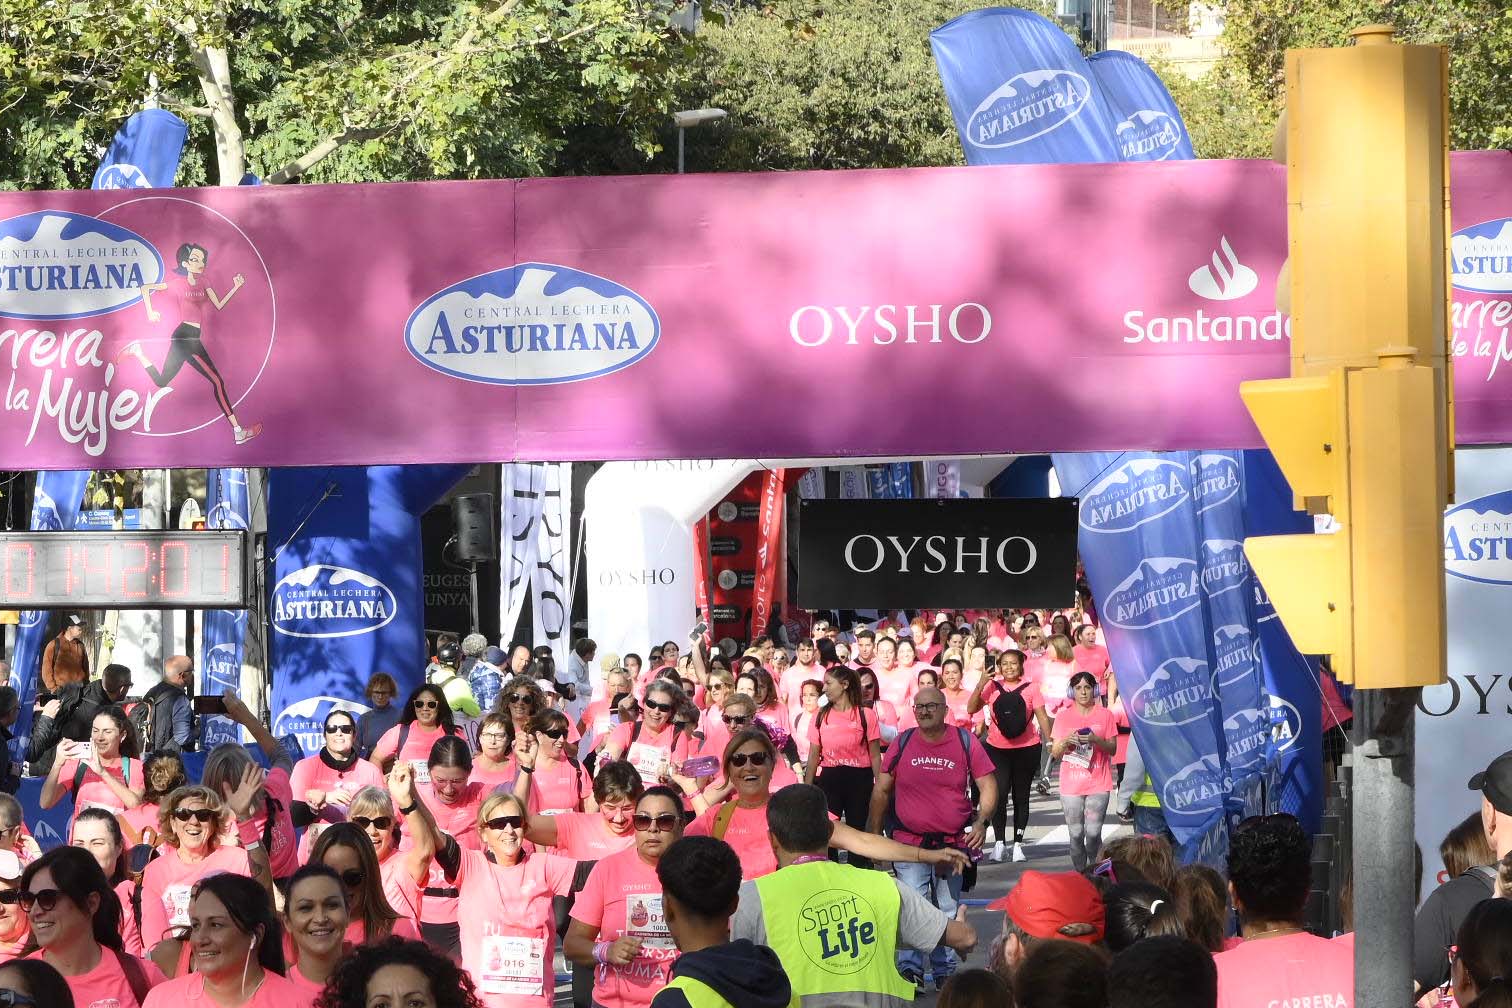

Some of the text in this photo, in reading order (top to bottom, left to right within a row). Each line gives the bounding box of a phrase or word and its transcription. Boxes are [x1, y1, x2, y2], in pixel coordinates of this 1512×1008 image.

[66, 246, 139, 259] LECHERA
[464, 304, 632, 319] CENTRAL LECHERA
[789, 302, 992, 346] OYSHO
[424, 310, 640, 355] ASTURIANA
[5, 370, 30, 412] la
[25, 363, 174, 457] Mujer
[5, 541, 230, 599] 01:42:01
[844, 534, 1038, 575] OYSHO
[286, 589, 383, 598] CENTRAL LECHERA
[599, 567, 675, 586] OYSHO
[274, 592, 387, 621] ASTURIANA
[911, 756, 956, 769] CHANETE
[802, 896, 861, 932] Sport
[818, 917, 876, 960] Life
